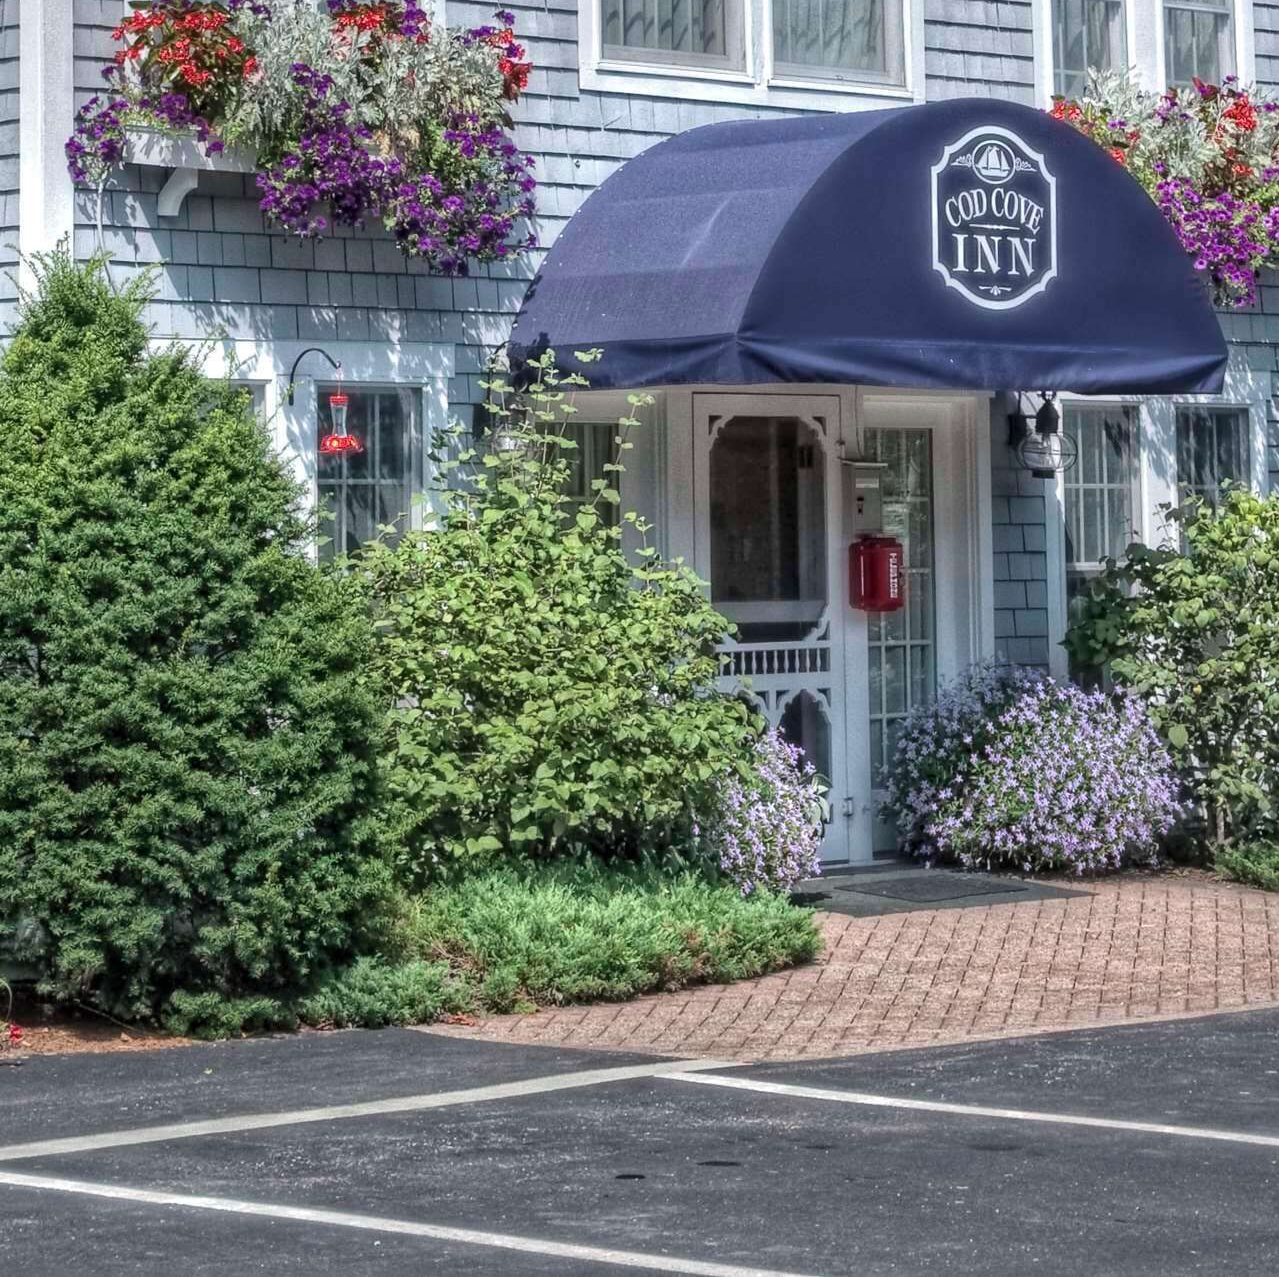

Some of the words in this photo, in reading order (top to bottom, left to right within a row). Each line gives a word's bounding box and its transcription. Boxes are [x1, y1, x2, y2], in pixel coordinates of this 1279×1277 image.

[945, 188, 987, 227] COD
[991, 187, 1044, 235] COVE
[951, 233, 1037, 277] INN
